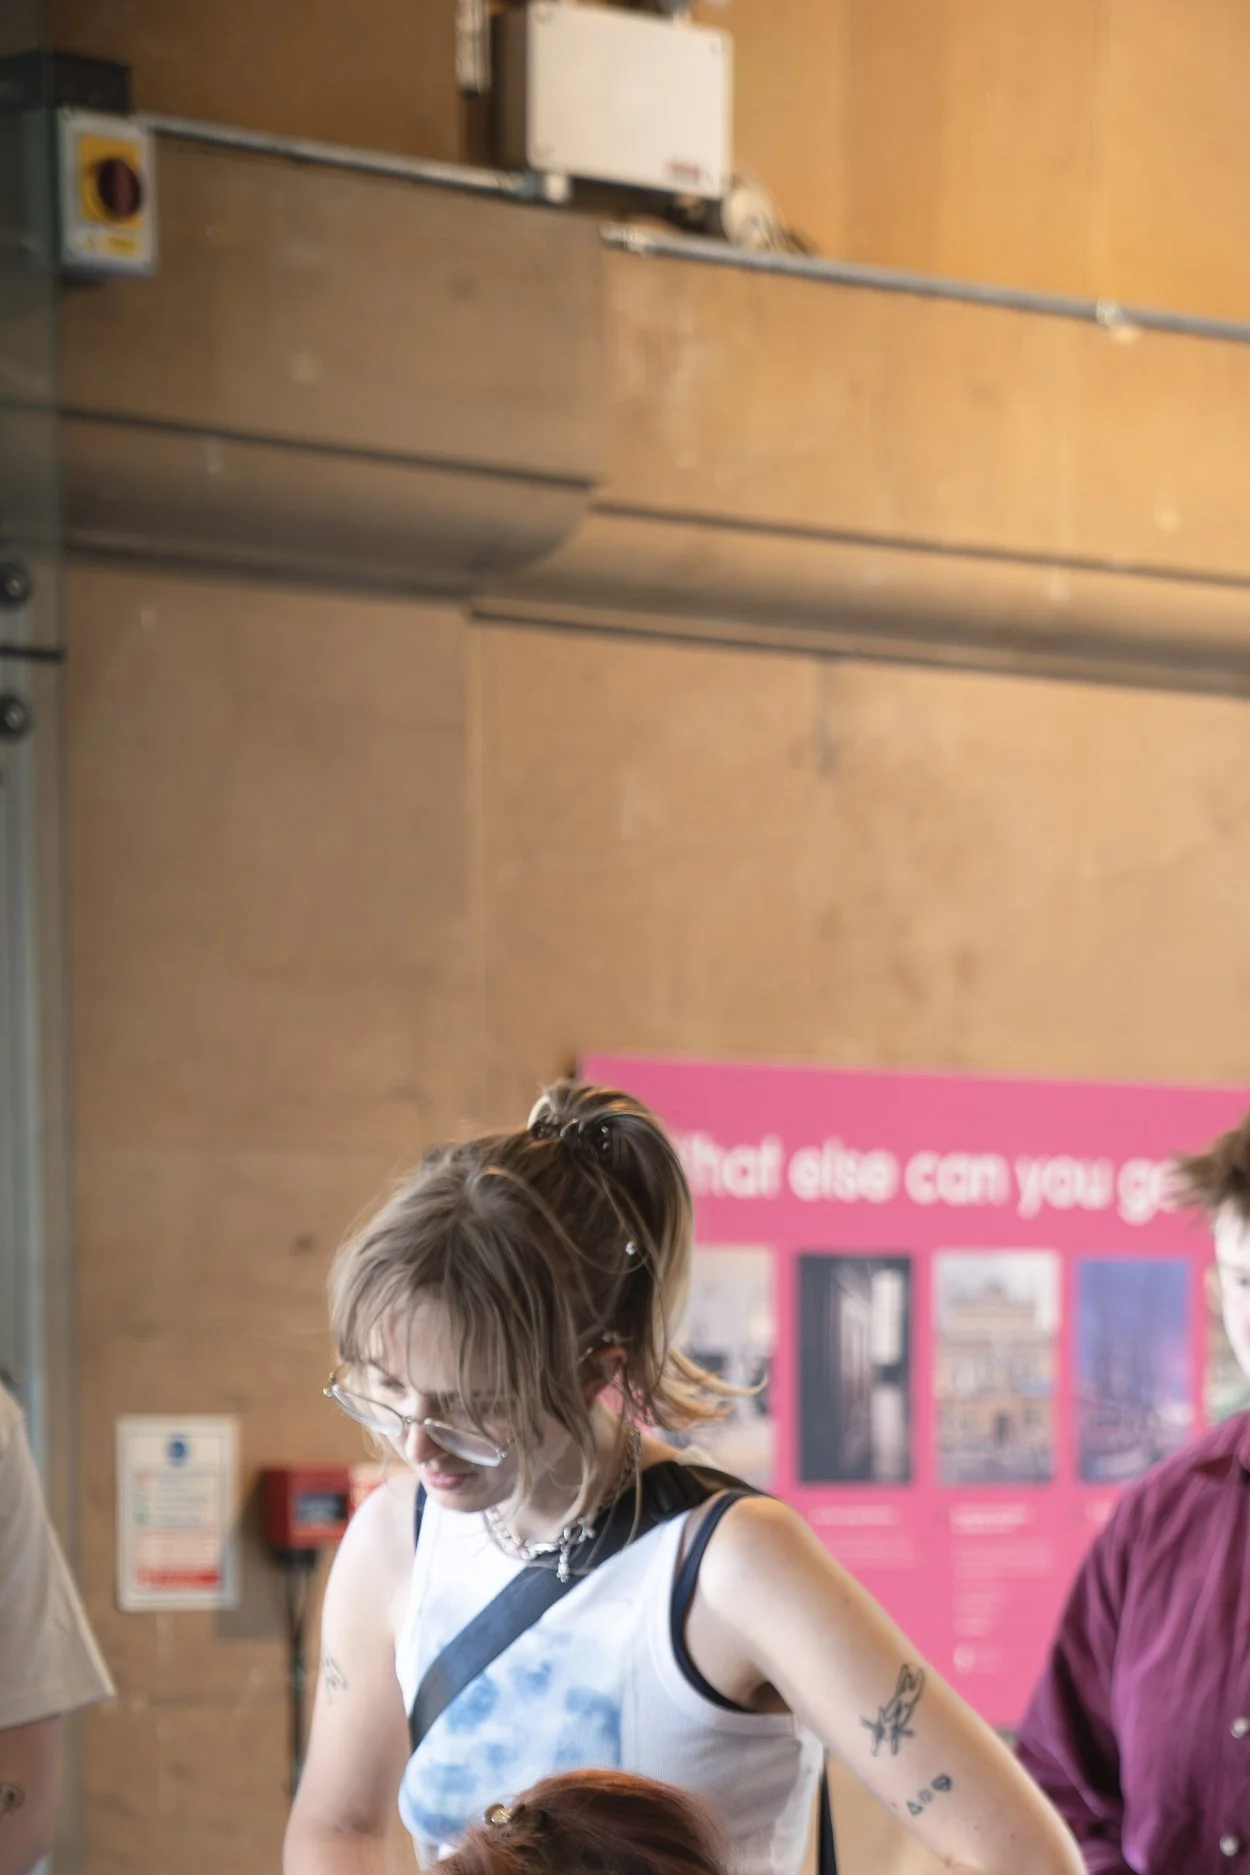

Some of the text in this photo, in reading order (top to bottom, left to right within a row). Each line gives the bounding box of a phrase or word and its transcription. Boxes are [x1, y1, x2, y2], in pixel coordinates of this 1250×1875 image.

[789, 1137, 898, 1202] else
[905, 1151, 1008, 1205] can
[1015, 1155, 1112, 1219] you
[1118, 1157, 1184, 1226] ge
